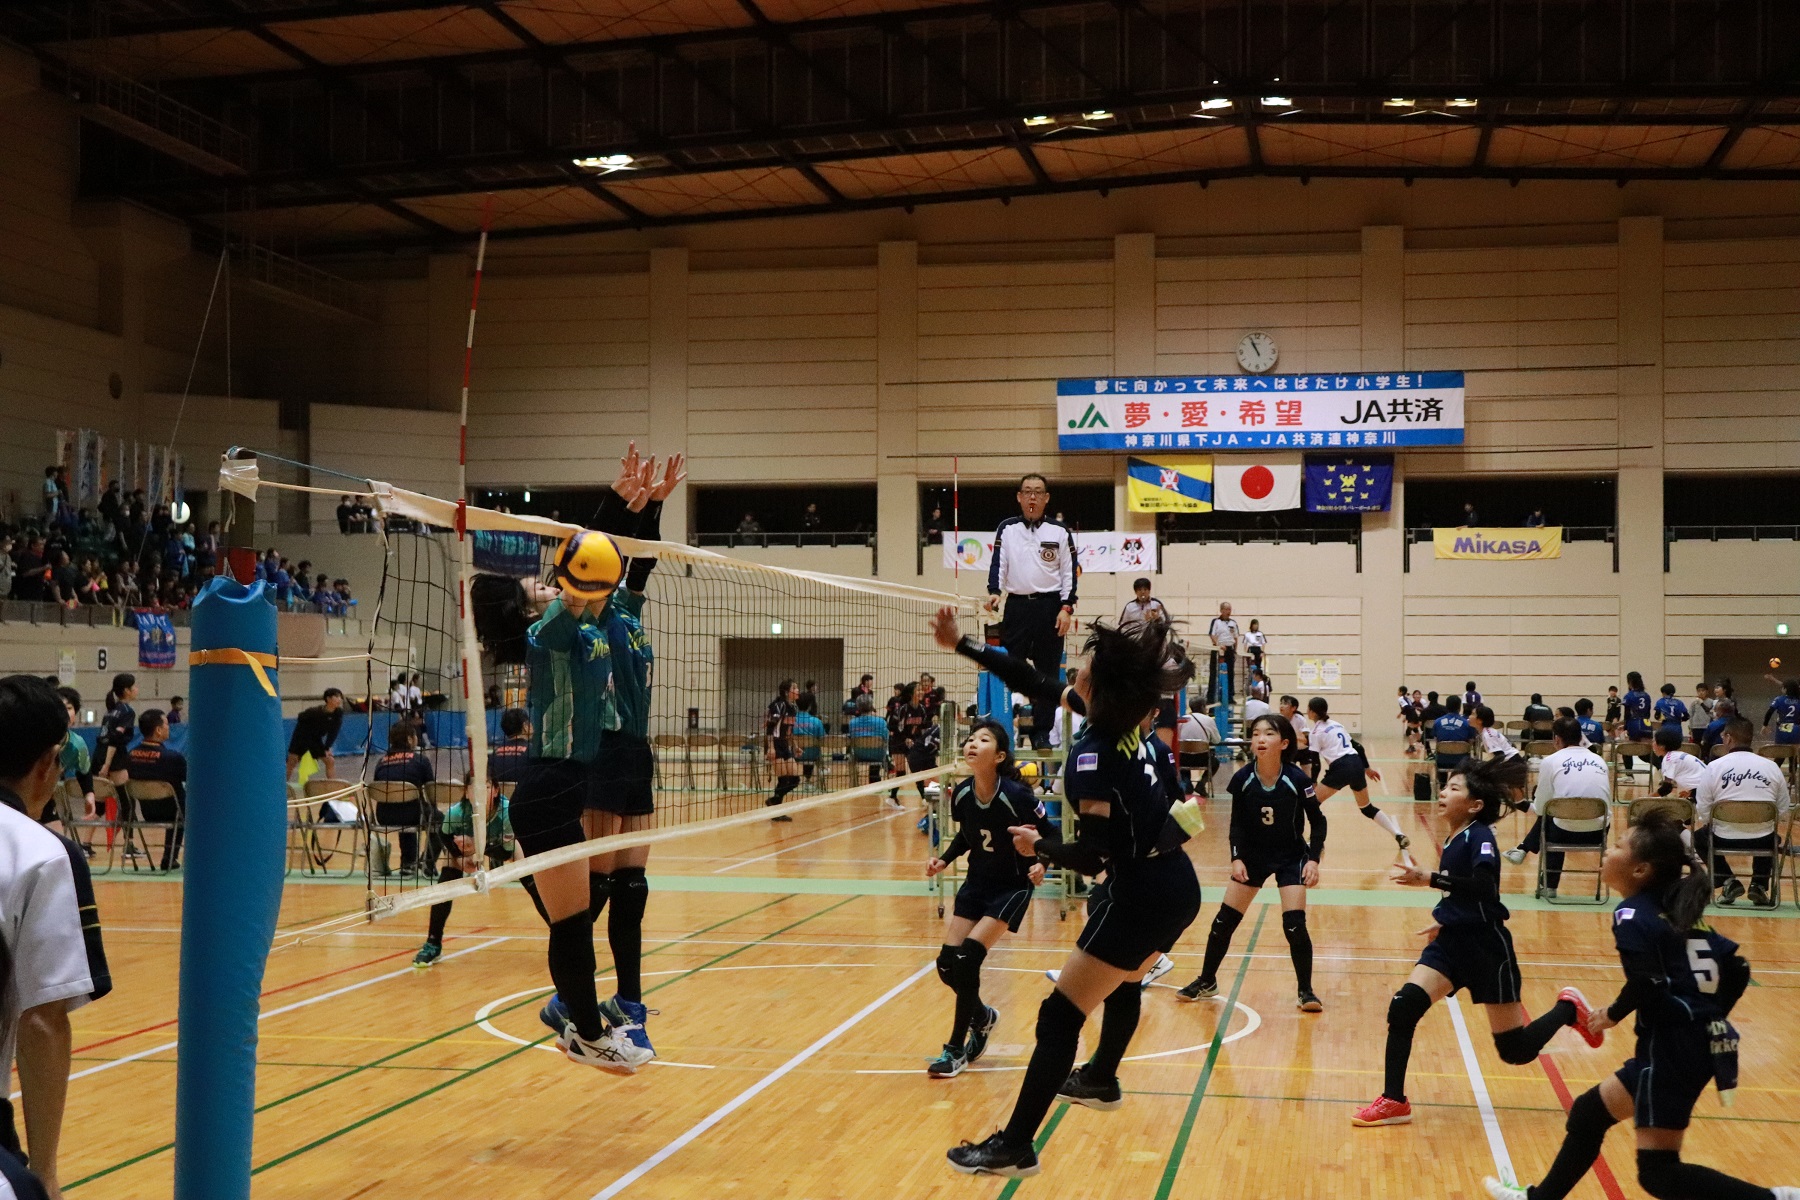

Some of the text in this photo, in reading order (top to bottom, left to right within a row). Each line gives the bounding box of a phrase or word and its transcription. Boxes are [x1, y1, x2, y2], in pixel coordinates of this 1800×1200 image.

[1094, 374, 1423, 393] 夢に向かって未来へはばたけ小学生!
[1124, 400, 1302, 428] 夢・愛・希望
[1340, 398, 1444, 424] JA共済
[1125, 431, 1396, 447] 神奈川県下JA・JA共済連神奈川
[98, 648, 107, 670] B
[1638, 697, 1646, 710] 3
[1785, 705, 1796, 718] 2
[1337, 732, 1350, 748] 2
[1261, 806, 1275, 826] 3
[980, 828, 995, 852] 2
[1685, 938, 1720, 994] 5
